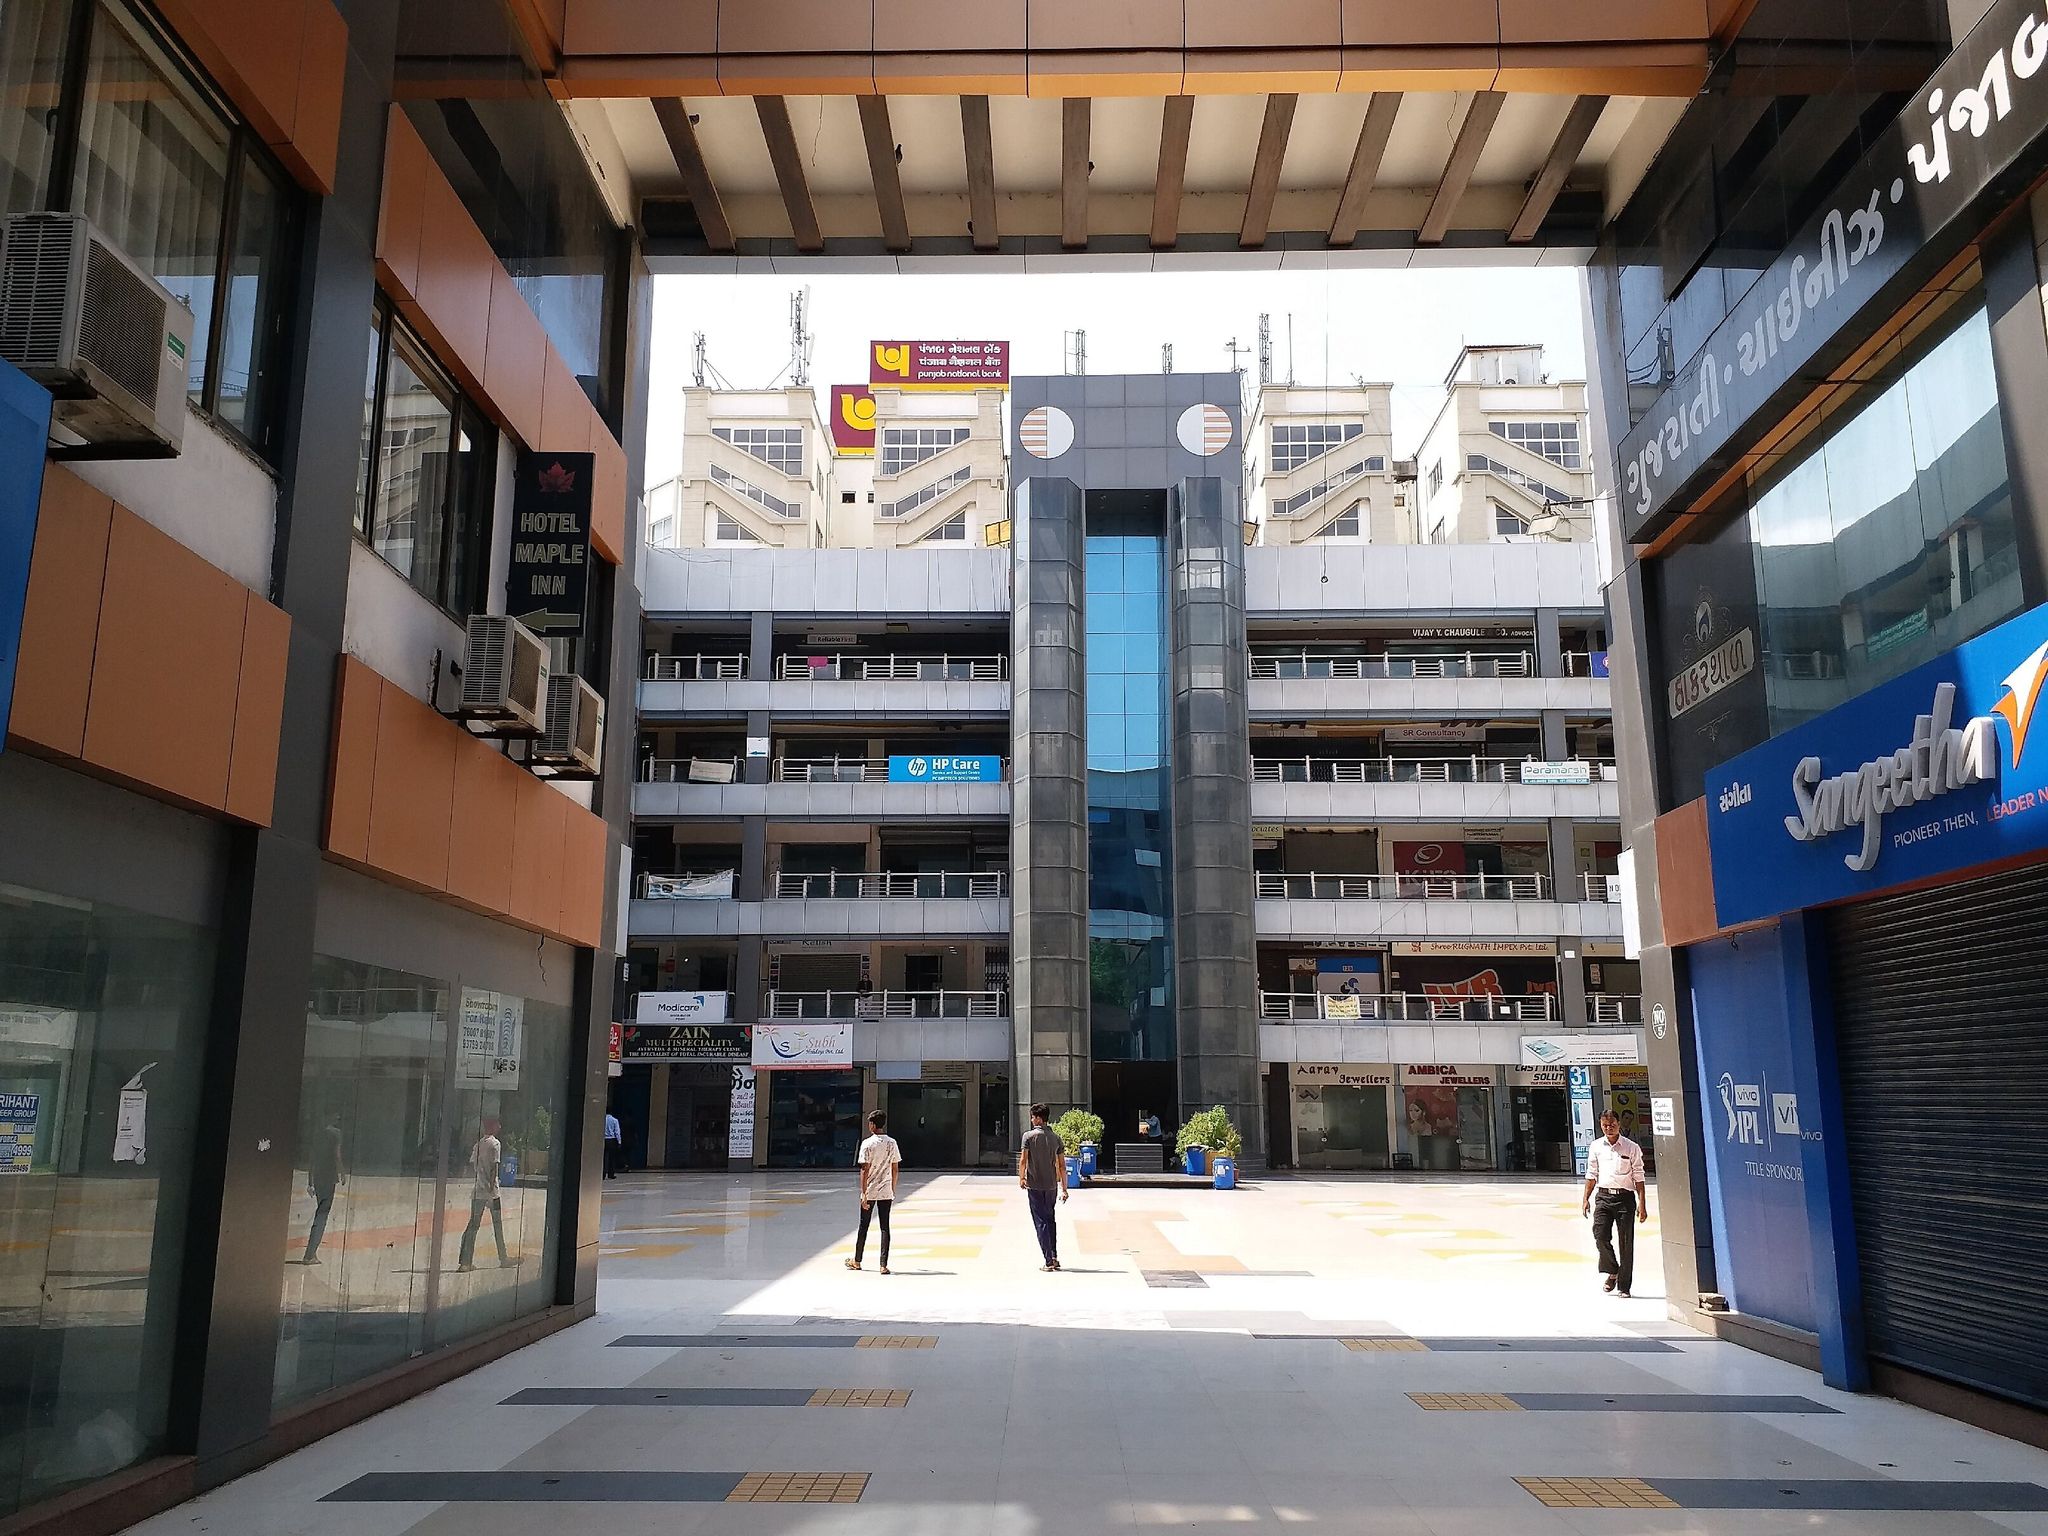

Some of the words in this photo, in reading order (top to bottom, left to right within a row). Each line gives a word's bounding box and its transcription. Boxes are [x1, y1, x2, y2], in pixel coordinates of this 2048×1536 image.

[918, 369, 946, 380] punjab
[946, 369, 981, 378] national
[981, 369, 1002, 378] bank
[1627, 353, 1721, 516] ગુજરાતી
[520, 512, 581, 533] HOTEL
[514, 543, 585, 564] MAPLE
[531, 575, 567, 595] INN
[1412, 628, 1434, 637] VIJAY
[1436, 628, 1443, 637] Y.
[1444, 628, 1486, 637] CHAUGULE
[1403, 729, 1414, 737] SR
[1416, 729, 1466, 739] Consultancy
[932, 758, 949, 770] HP
[952, 758, 980, 770] Care
[1524, 765, 1587, 775] Paramarsh
[1784, 683, 1996, 871] Sangeetha
[1719, 781, 1751, 812] સંગીતા
[1894, 821, 1942, 848] PIONEER
[1942, 811, 1979, 832] THEN,
[1986, 792, 2036, 822] LEADER
[1493, 943, 1518, 951] IMPEX
[658, 1003, 700, 1012] Modicare
[1653, 1010, 1664, 1024] NO
[669, 1026, 711, 1039] ZAIN
[1657, 1026, 1663, 1036] 5
[645, 1039, 735, 1047] MULTISPECIALITY
[806, 1034, 836, 1048] Subh
[1297, 1065, 1339, 1075] Aarav
[1408, 1065, 1458, 1075] AMBICA
[1534, 1072, 1566, 1081] SOLUT
[1570, 1066, 1591, 1087] 31
[1339, 1074, 1390, 1084] Jewellers
[1439, 1076, 1490, 1085] JEWELLERS
[1737, 1088, 1758, 1101] vivo
[13, 1109, 37, 1118] GROUP
[1778, 1099, 1798, 1126] vi
[1737, 1110, 1764, 1145] IPL
[1800, 1128, 1823, 1141] vivo
[1745, 1161, 1765, 1177] TITLE
[1766, 1163, 1803, 1182] SPONSOR
